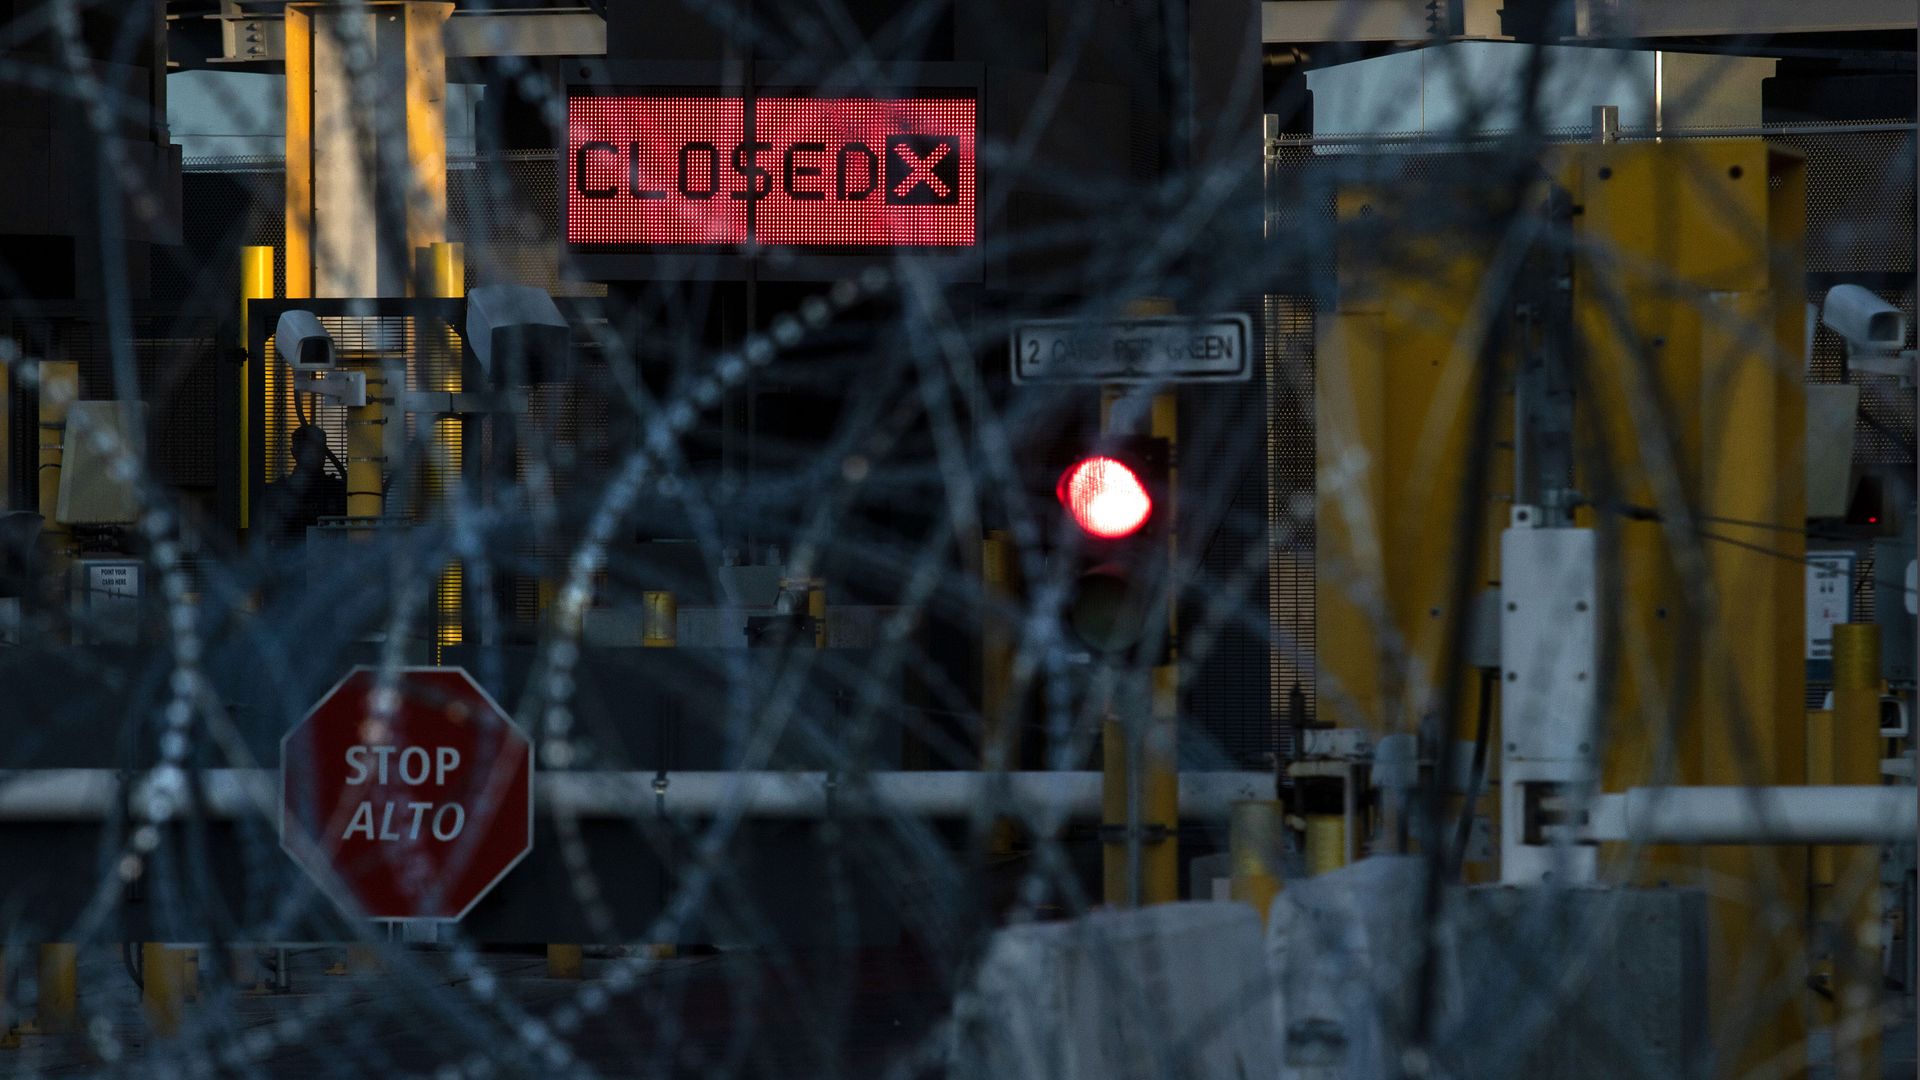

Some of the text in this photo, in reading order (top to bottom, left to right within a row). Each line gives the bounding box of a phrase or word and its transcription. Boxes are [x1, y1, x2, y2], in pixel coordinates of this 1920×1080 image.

[575, 141, 879, 200] CLOSED
[1027, 339, 1040, 364] 2
[344, 745, 461, 786] STOP
[341, 800, 466, 842] ALTO
